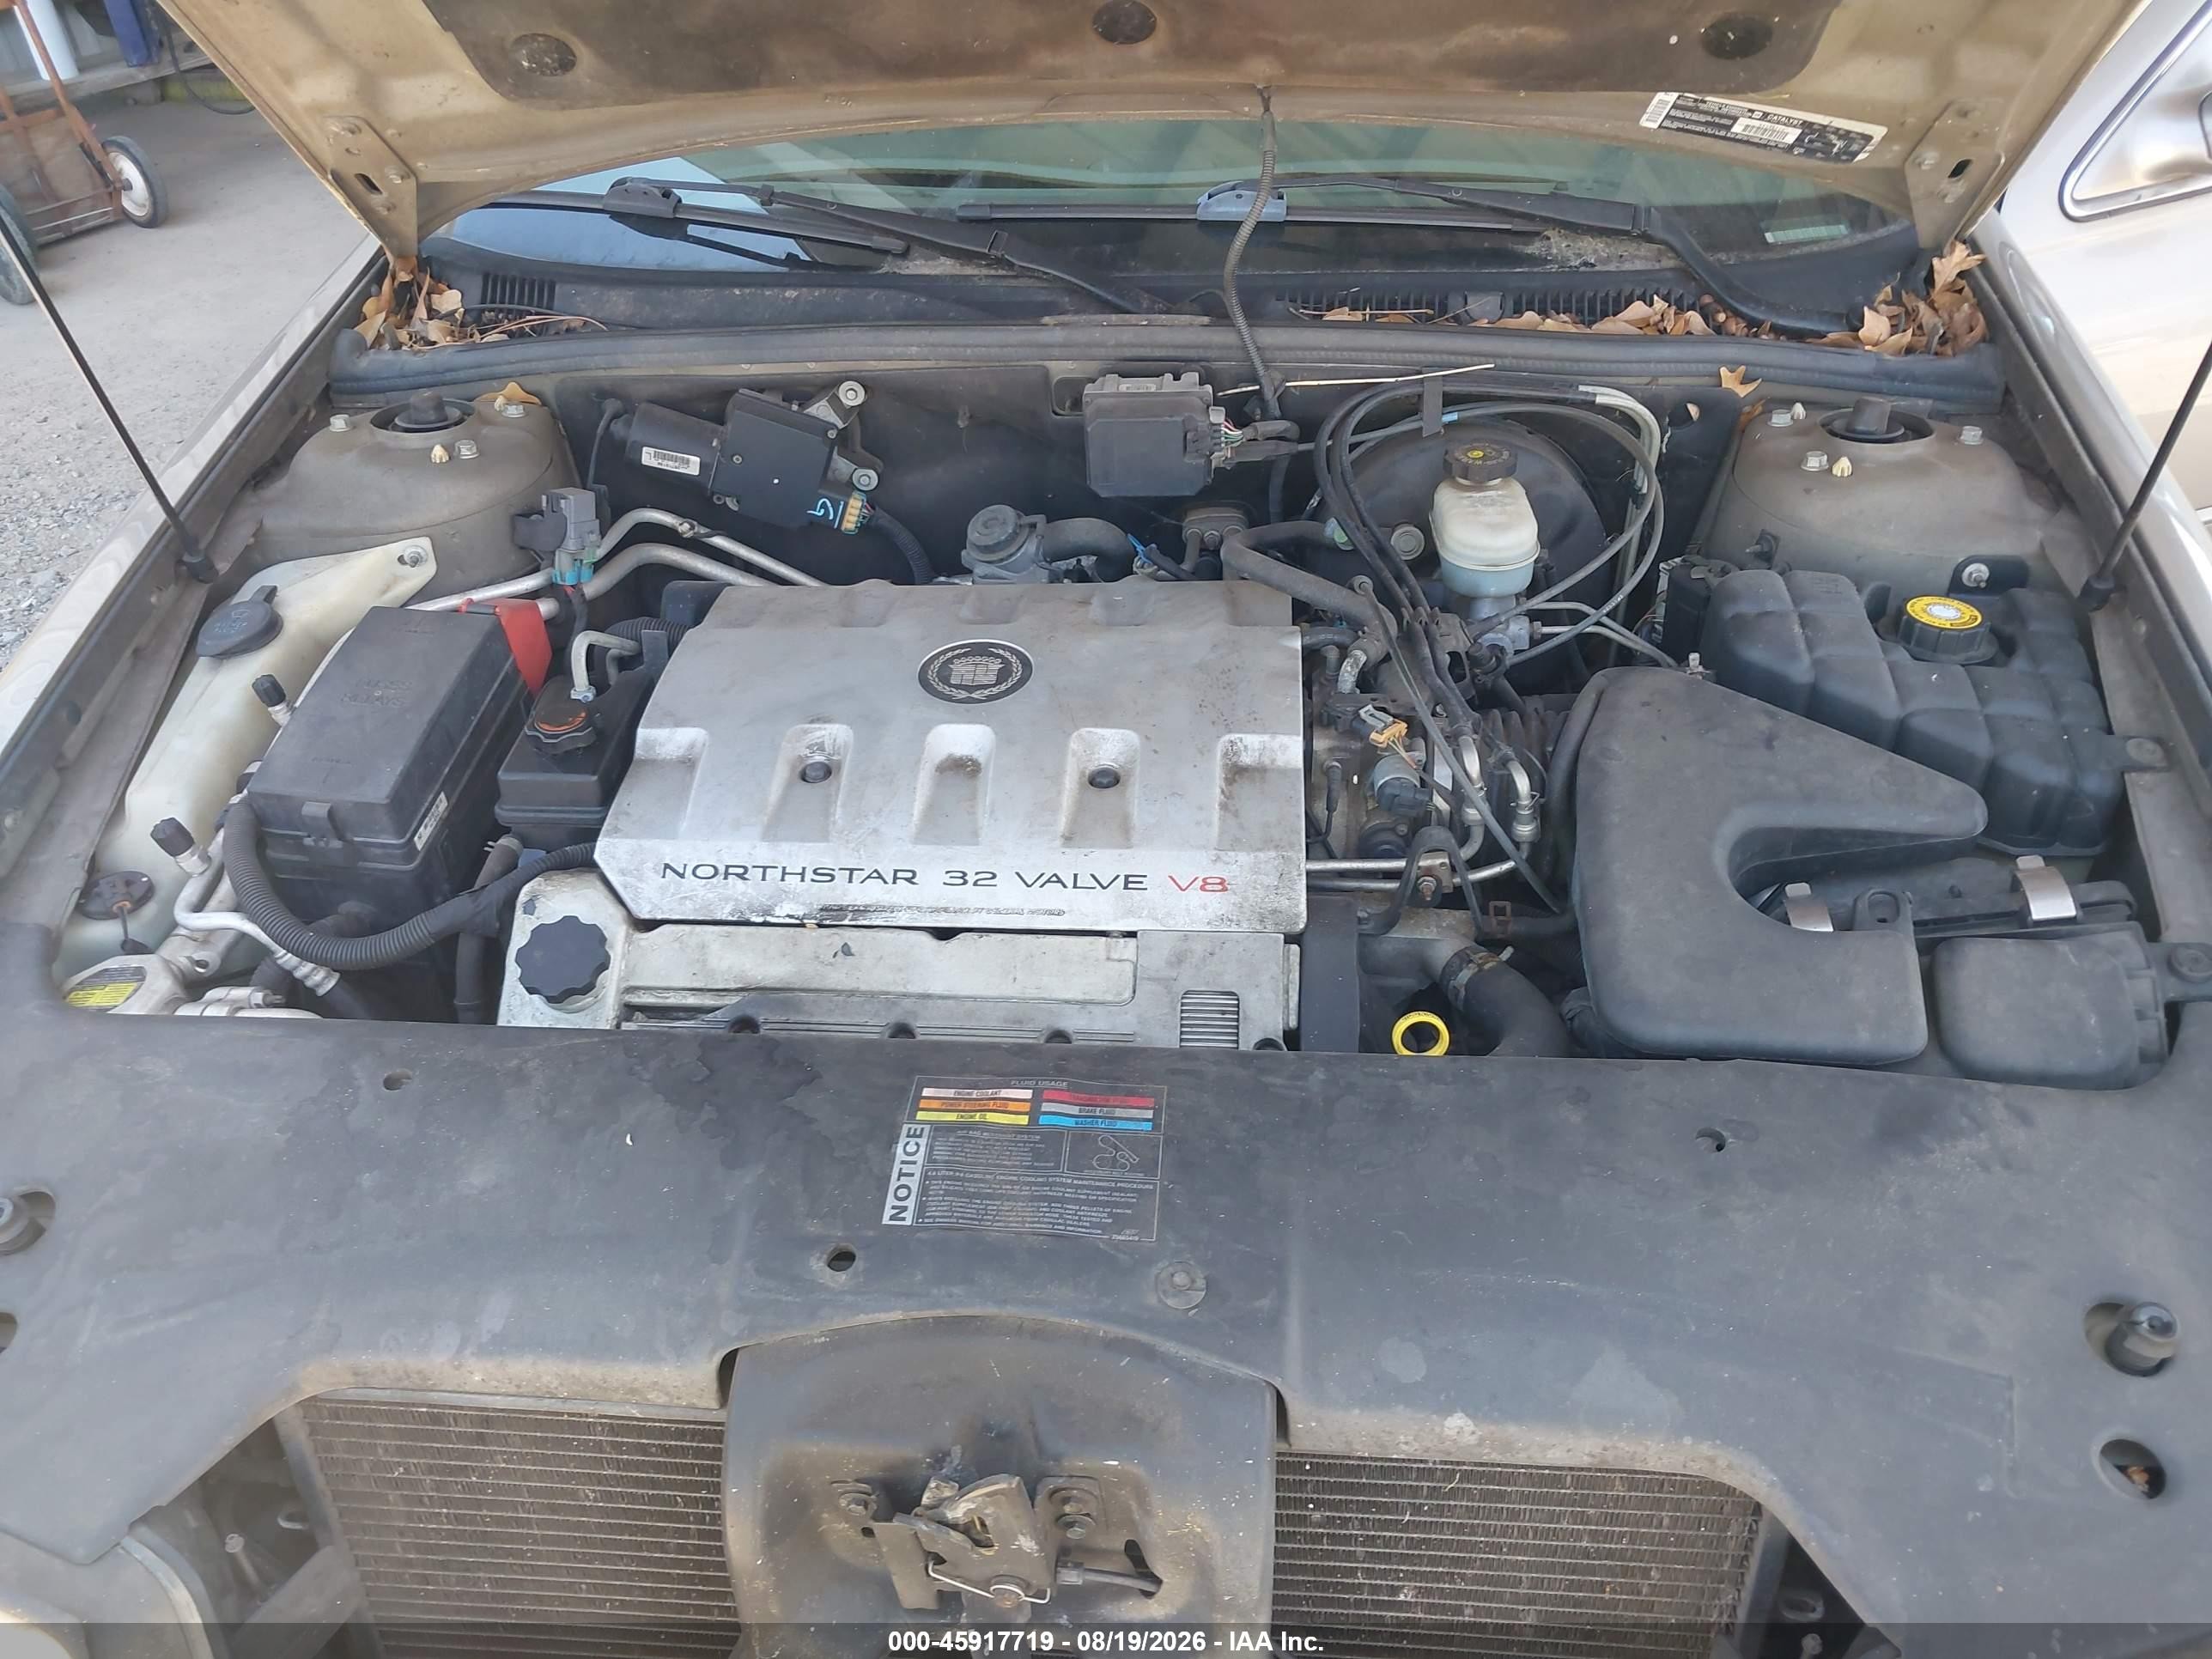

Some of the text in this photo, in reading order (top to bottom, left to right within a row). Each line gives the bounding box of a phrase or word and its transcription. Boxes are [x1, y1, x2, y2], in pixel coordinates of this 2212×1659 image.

[1767, 112, 1803, 125] CATALYST
[660, 862, 1229, 893] NORTHSTAR 32 VALVE V8
[889, 1127, 925, 1222] NOTICE
